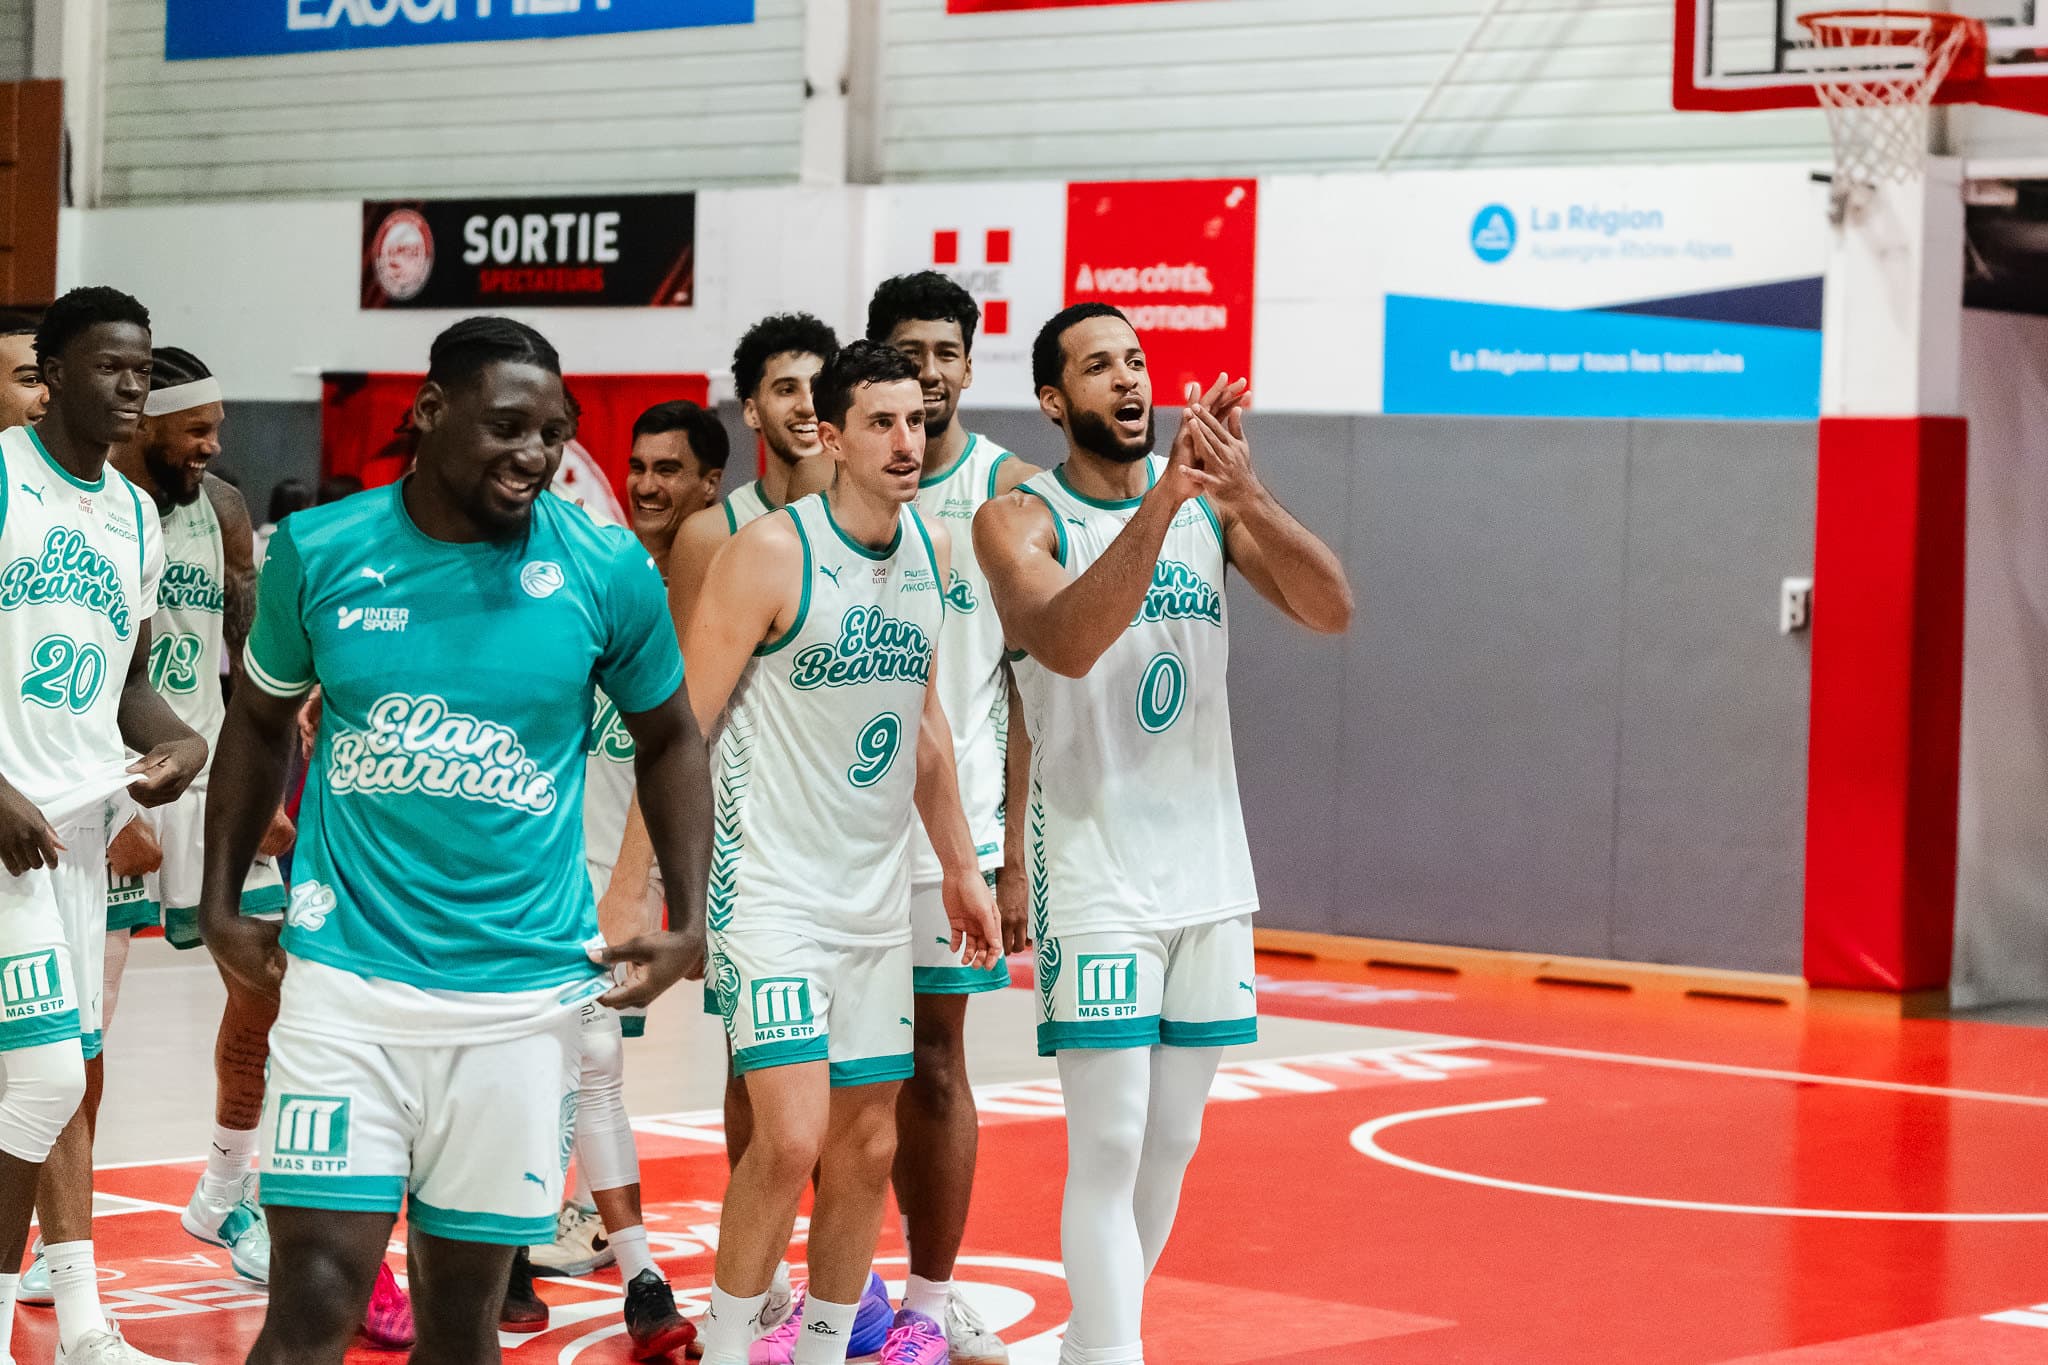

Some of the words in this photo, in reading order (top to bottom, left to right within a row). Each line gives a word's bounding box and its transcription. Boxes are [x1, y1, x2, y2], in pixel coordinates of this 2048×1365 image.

[1530, 207, 1560, 232] La
[1567, 204, 1664, 236] Région
[463, 211, 620, 264] SORTIE
[480, 267, 604, 293] SPECTATEURS
[1075, 263, 1093, 292] À
[1095, 267, 1137, 293] VOS
[1139, 262, 1214, 295] CÔTÉS,
[1116, 305, 1227, 330] UOTIDIEN
[1451, 350, 1475, 372] La
[1477, 349, 1546, 377] Région
[1547, 354, 1581, 373] sur
[1583, 351, 1629, 373] tous
[1630, 349, 1662, 373] les
[1663, 350, 1745, 374] terrains
[39, 525, 121, 594] Elan
[0, 556, 132, 641] Bearnis
[364, 607, 409, 620] INTER
[362, 619, 408, 632] SPORT
[836, 605, 930, 658] Elan
[21, 634, 107, 714] 20
[148, 632, 203, 694] 13
[789, 643, 933, 690] Bearnai
[1136, 652, 1187, 734] 0
[366, 692, 526, 768] Elan
[848, 711, 902, 788] 9
[107, 894, 120, 904] AS
[288, 879, 337, 931] 12
[6, 1005, 35, 1018] MAS
[40, 999, 64, 1012] BTP
[1078, 1007, 1110, 1017] MAS
[1115, 1005, 1137, 1016] BTP
[754, 1028, 786, 1042] MAS
[790, 1026, 815, 1037] BTP
[272, 1157, 304, 1170] MAS
[312, 1160, 347, 1171] BTP
